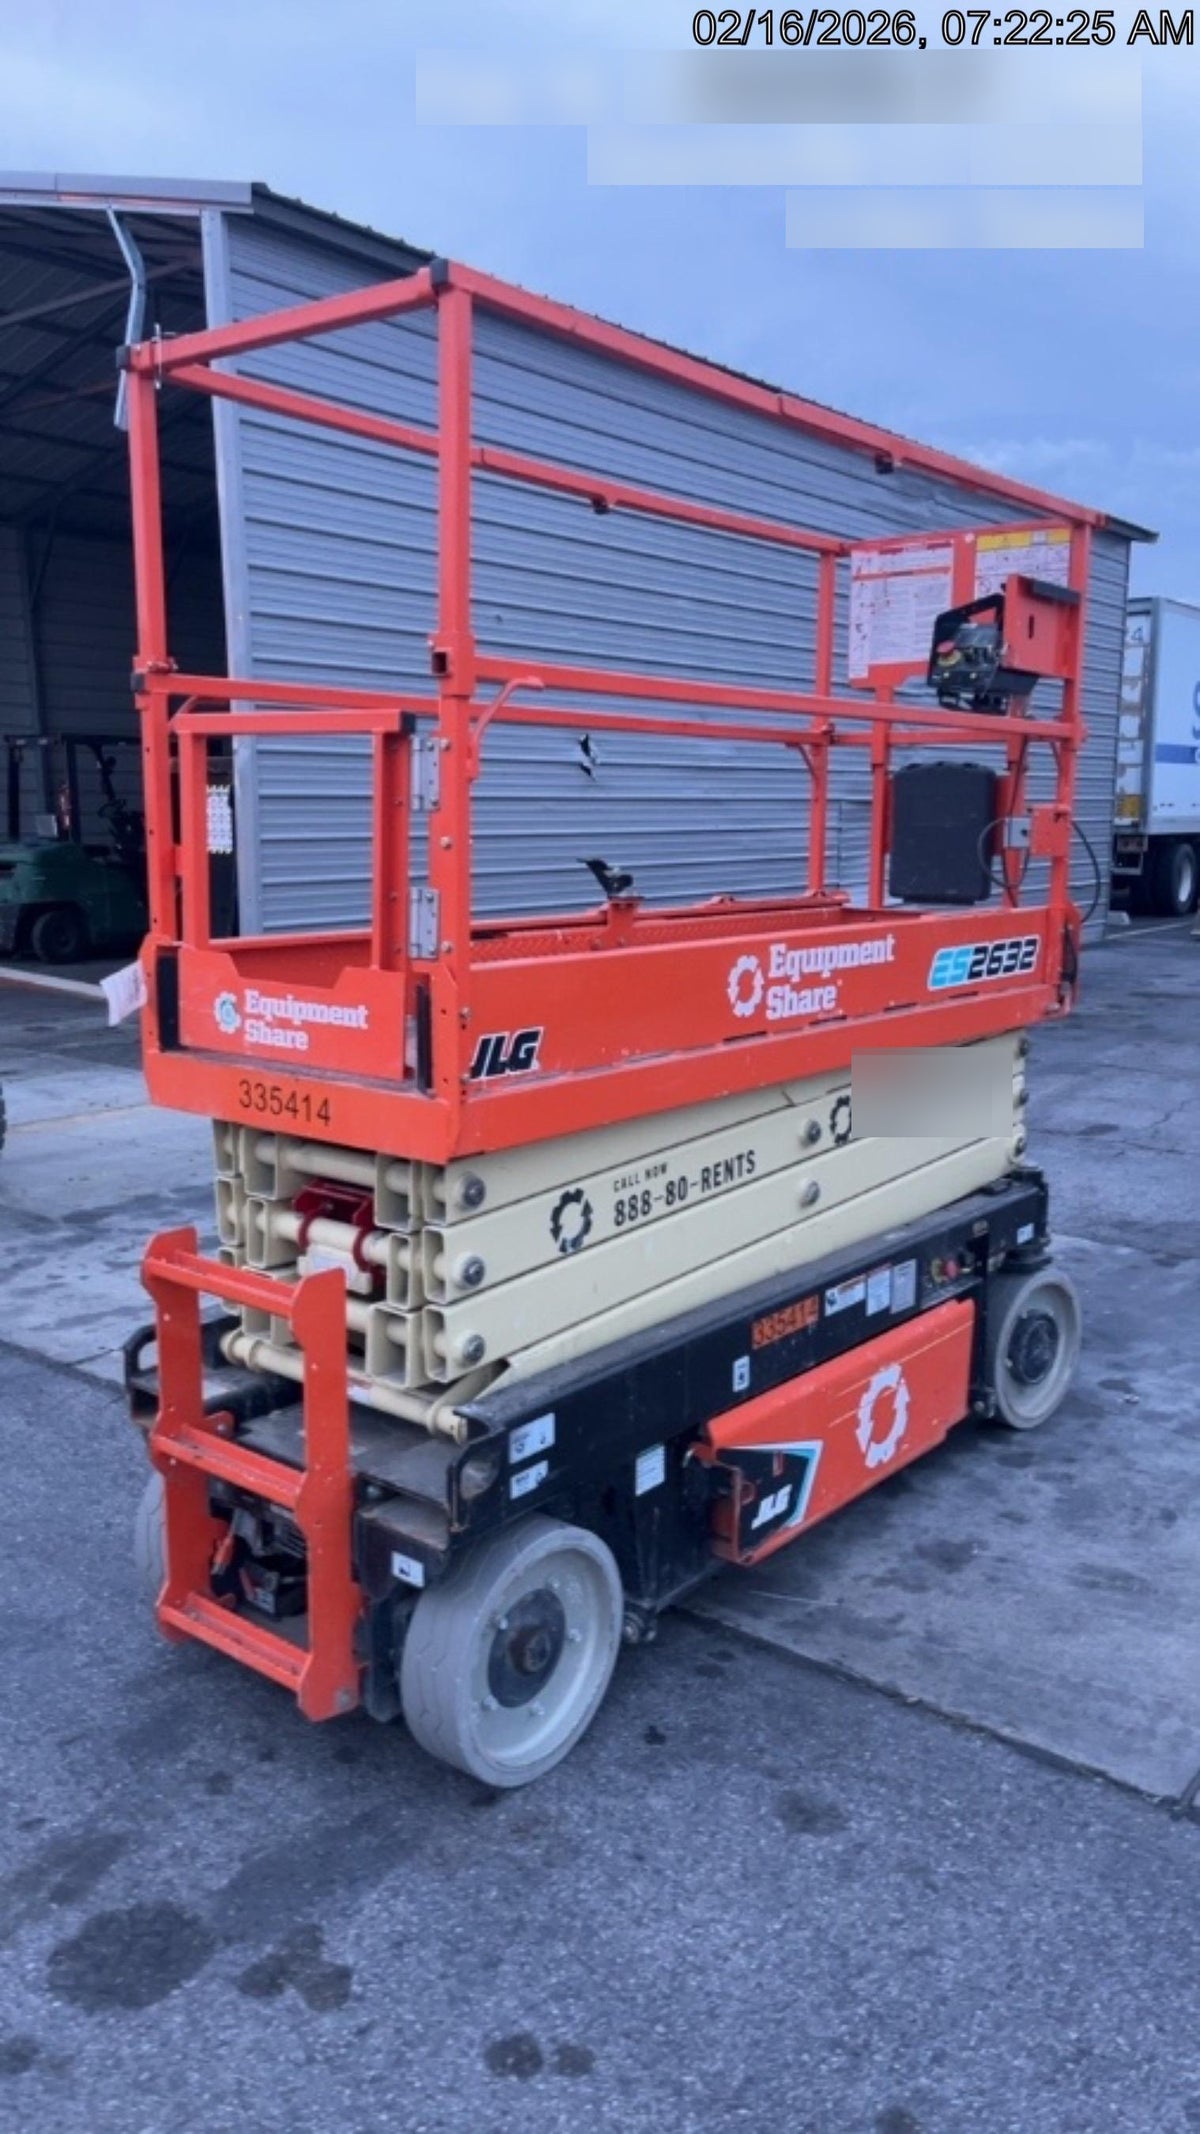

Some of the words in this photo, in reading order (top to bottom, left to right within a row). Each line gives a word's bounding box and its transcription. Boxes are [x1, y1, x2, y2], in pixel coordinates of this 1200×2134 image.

[769, 934, 895, 982] Equipment
[929, 935, 1039, 991] ES2632
[243, 988, 369, 1030] Equipment
[766, 984, 837, 1020] Share
[243, 1018, 309, 1050] Share
[469, 1027, 544, 1081] JLG
[238, 1078, 331, 1126] 335414
[613, 1172, 641, 1193] CALL
[644, 1162, 668, 1181] NOW
[613, 1149, 756, 1227] 888-80-RENTS
[751, 1484, 793, 1531] JLG
